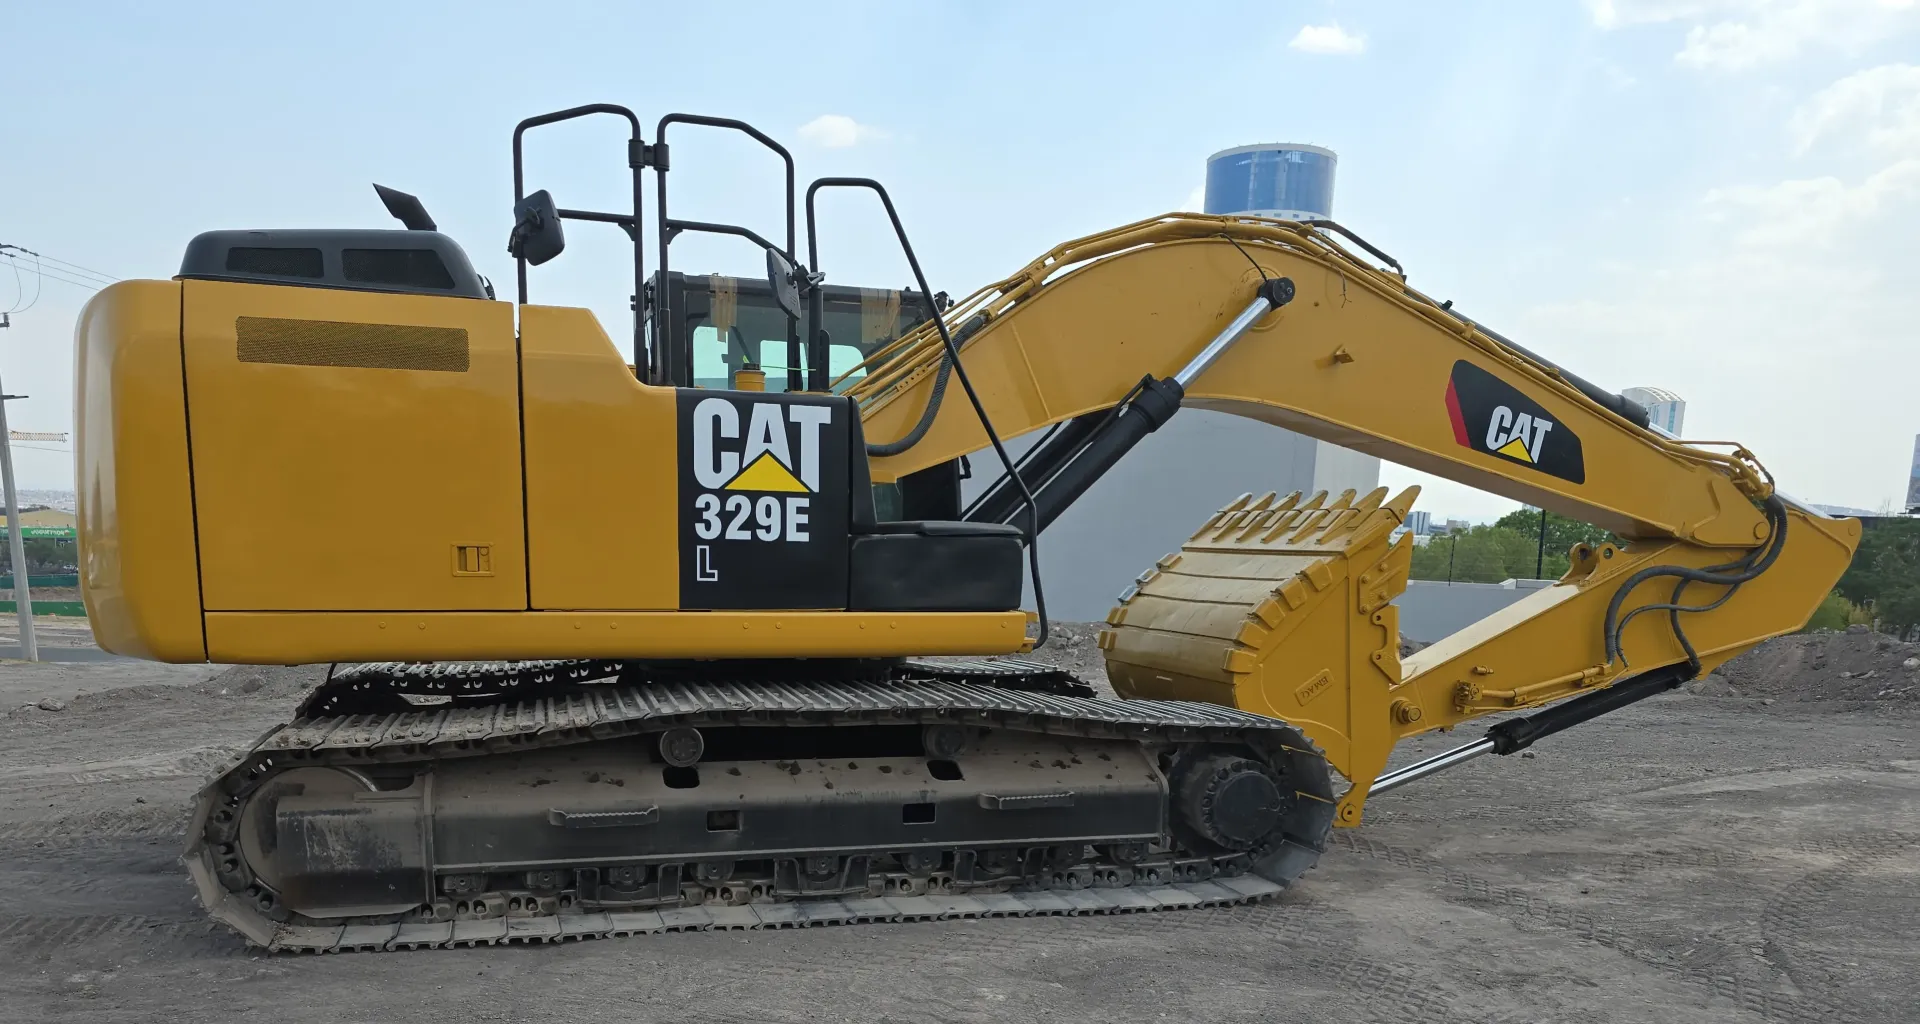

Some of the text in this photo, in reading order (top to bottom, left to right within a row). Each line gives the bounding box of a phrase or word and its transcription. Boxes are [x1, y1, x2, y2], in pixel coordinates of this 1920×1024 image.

[693, 398, 831, 493] CAT
[1486, 405, 1553, 464] CAT
[694, 493, 810, 542] 329E
[696, 545, 718, 582] L
